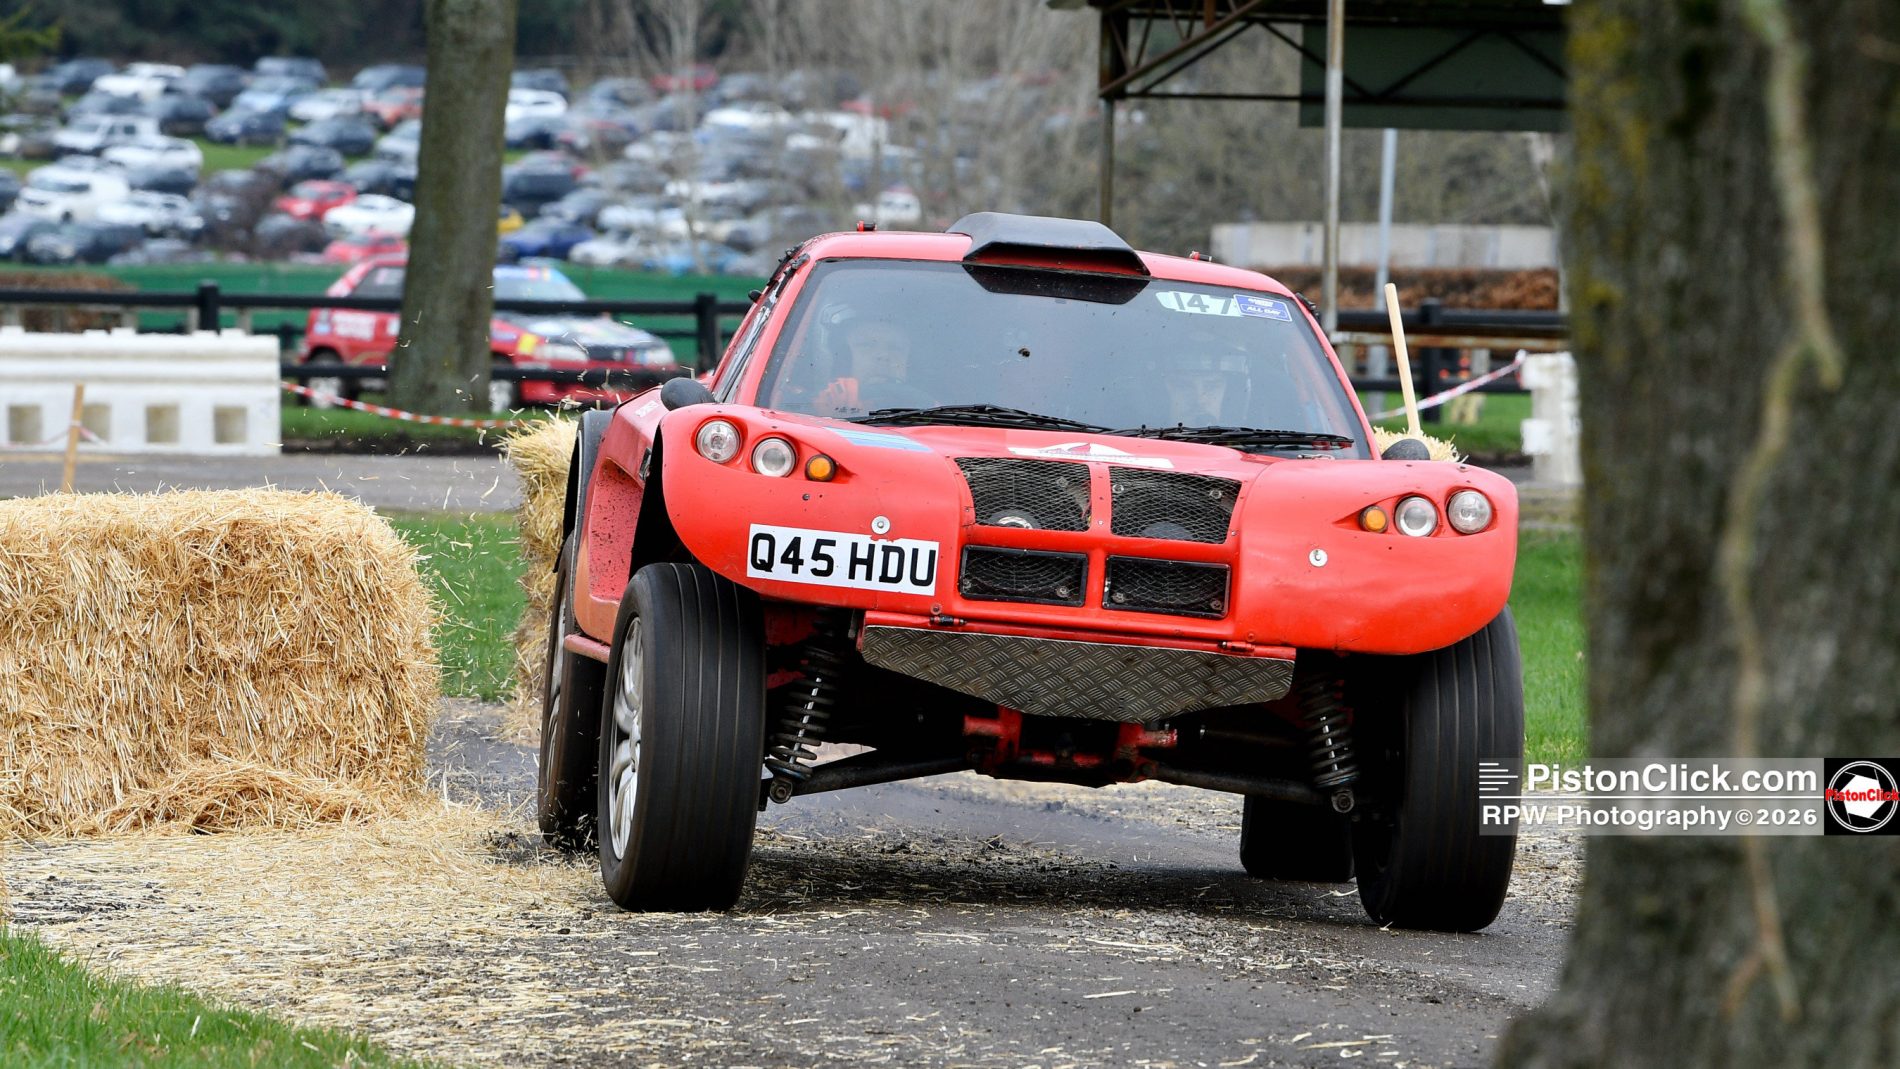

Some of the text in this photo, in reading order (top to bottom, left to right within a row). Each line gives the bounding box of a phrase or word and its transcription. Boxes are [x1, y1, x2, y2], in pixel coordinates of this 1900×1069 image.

[1174, 292, 1232, 315] 147
[750, 532, 936, 587] Q45 HDU
